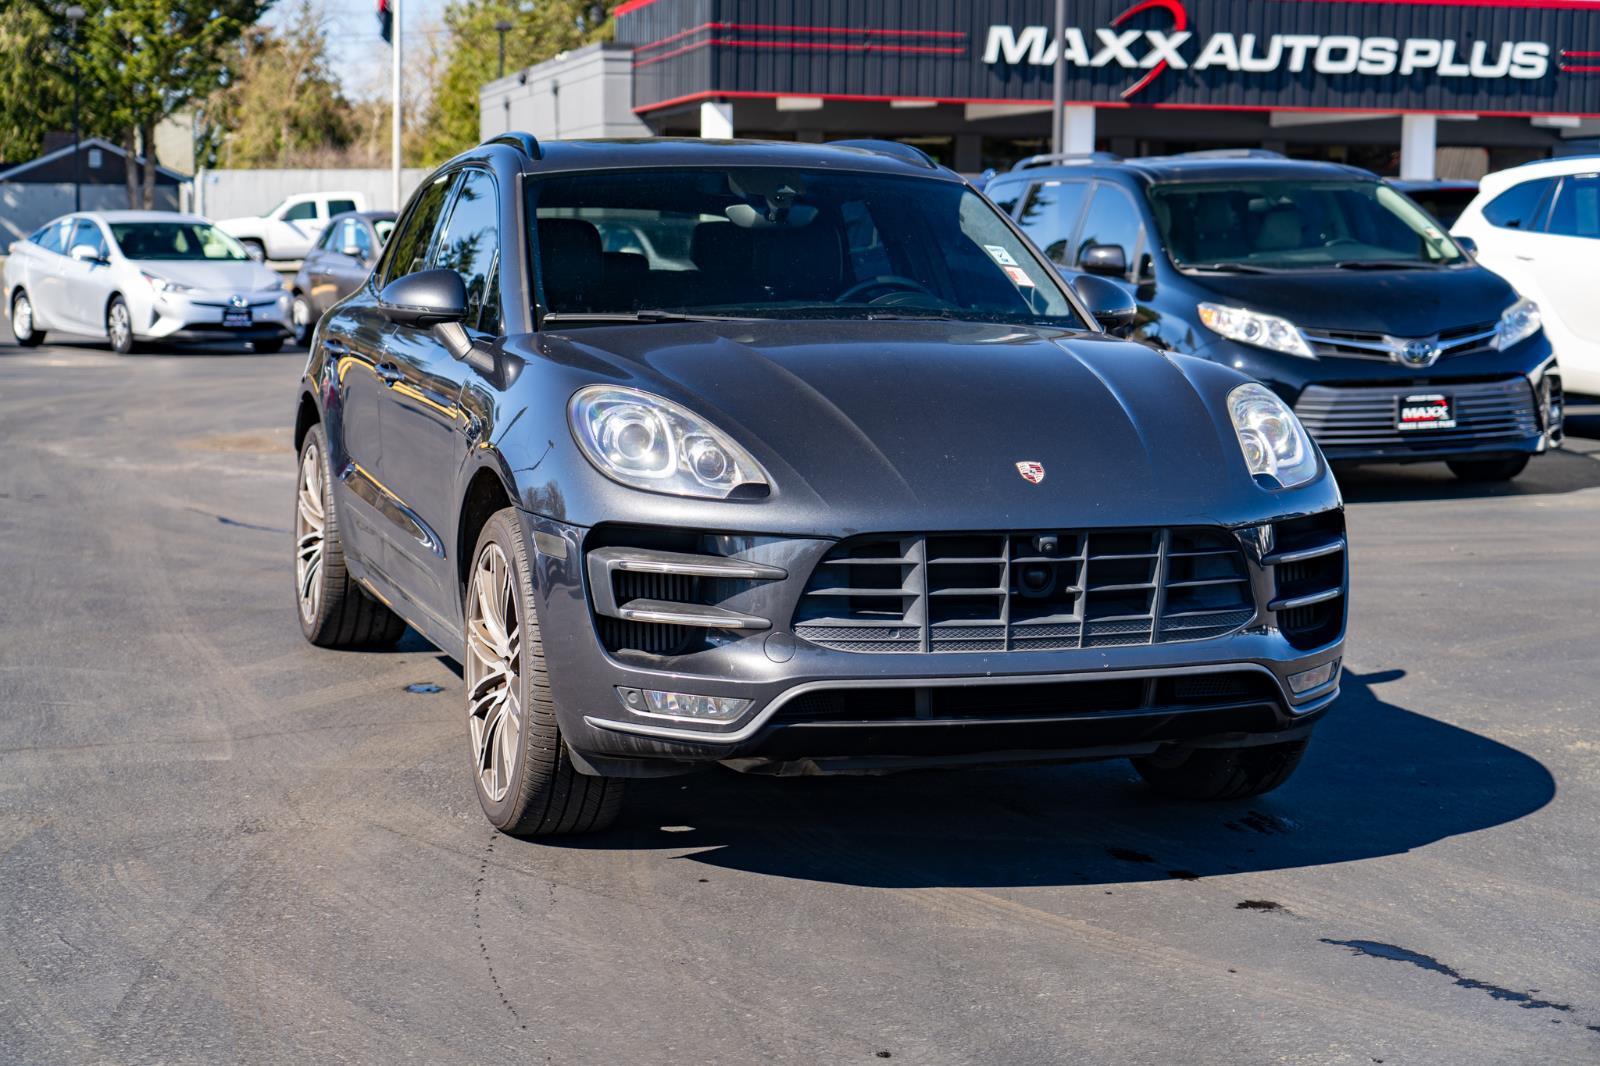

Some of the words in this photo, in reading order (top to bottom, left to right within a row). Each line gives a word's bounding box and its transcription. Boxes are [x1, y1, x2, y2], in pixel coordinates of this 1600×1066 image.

[982, 25, 1192, 69] MAXX
[1193, 32, 1399, 75] AUTOS
[1399, 38, 1550, 79] PLUS
[1402, 405, 1449, 420] MAXX
